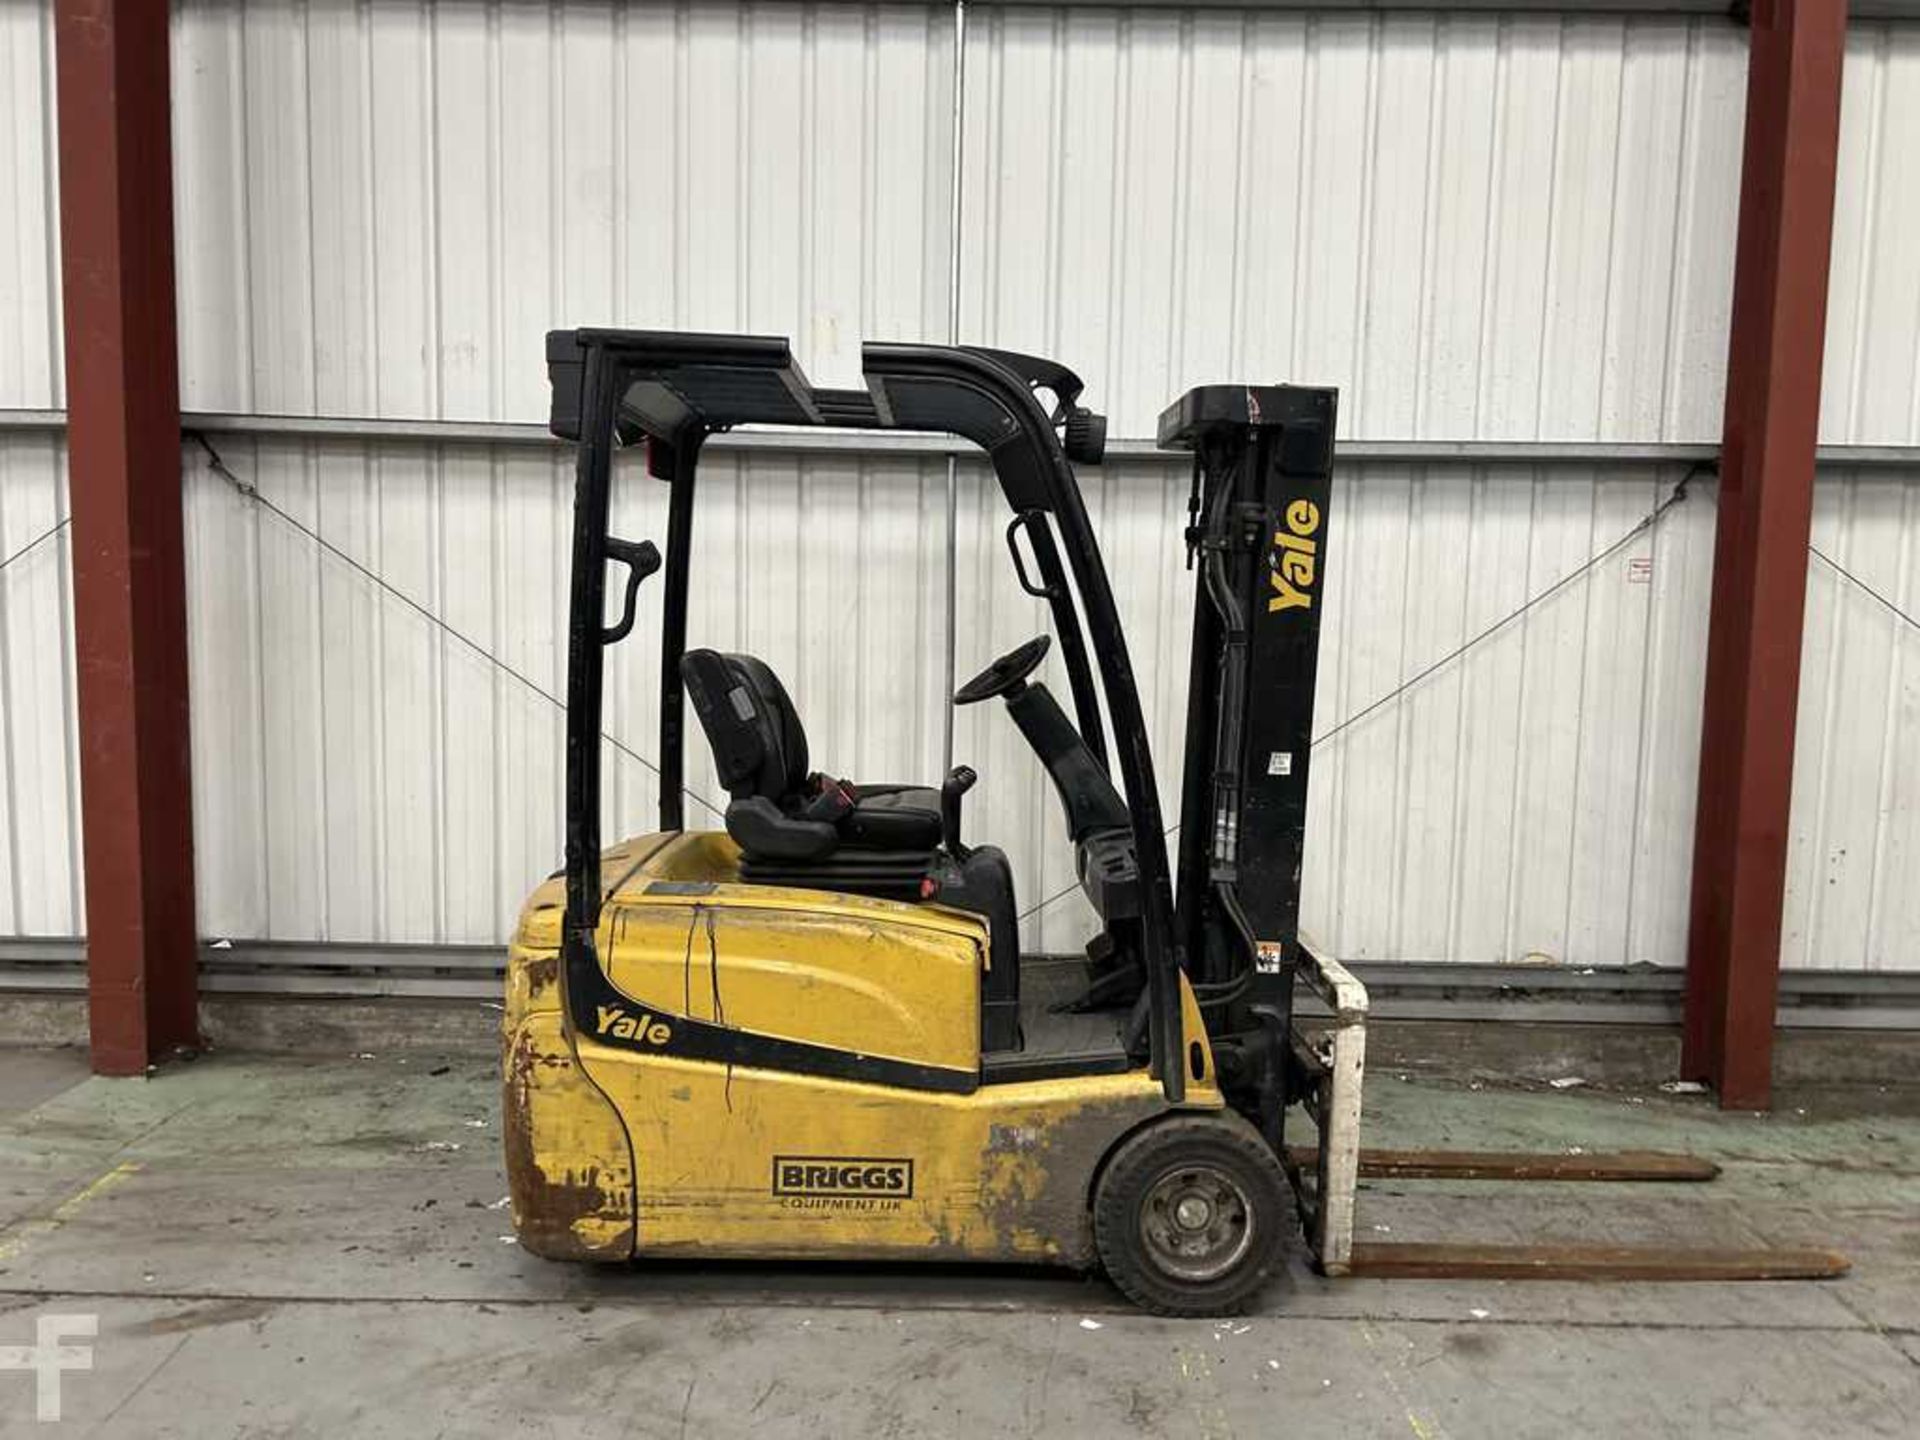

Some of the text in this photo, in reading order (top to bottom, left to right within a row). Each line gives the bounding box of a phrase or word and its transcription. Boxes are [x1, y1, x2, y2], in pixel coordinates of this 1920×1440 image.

[1269, 499, 1320, 613] Yale
[597, 1006, 671, 1045] Yale
[782, 1165, 904, 1190] BRIGGS
[780, 1198, 876, 1211] EQUIPMENT
